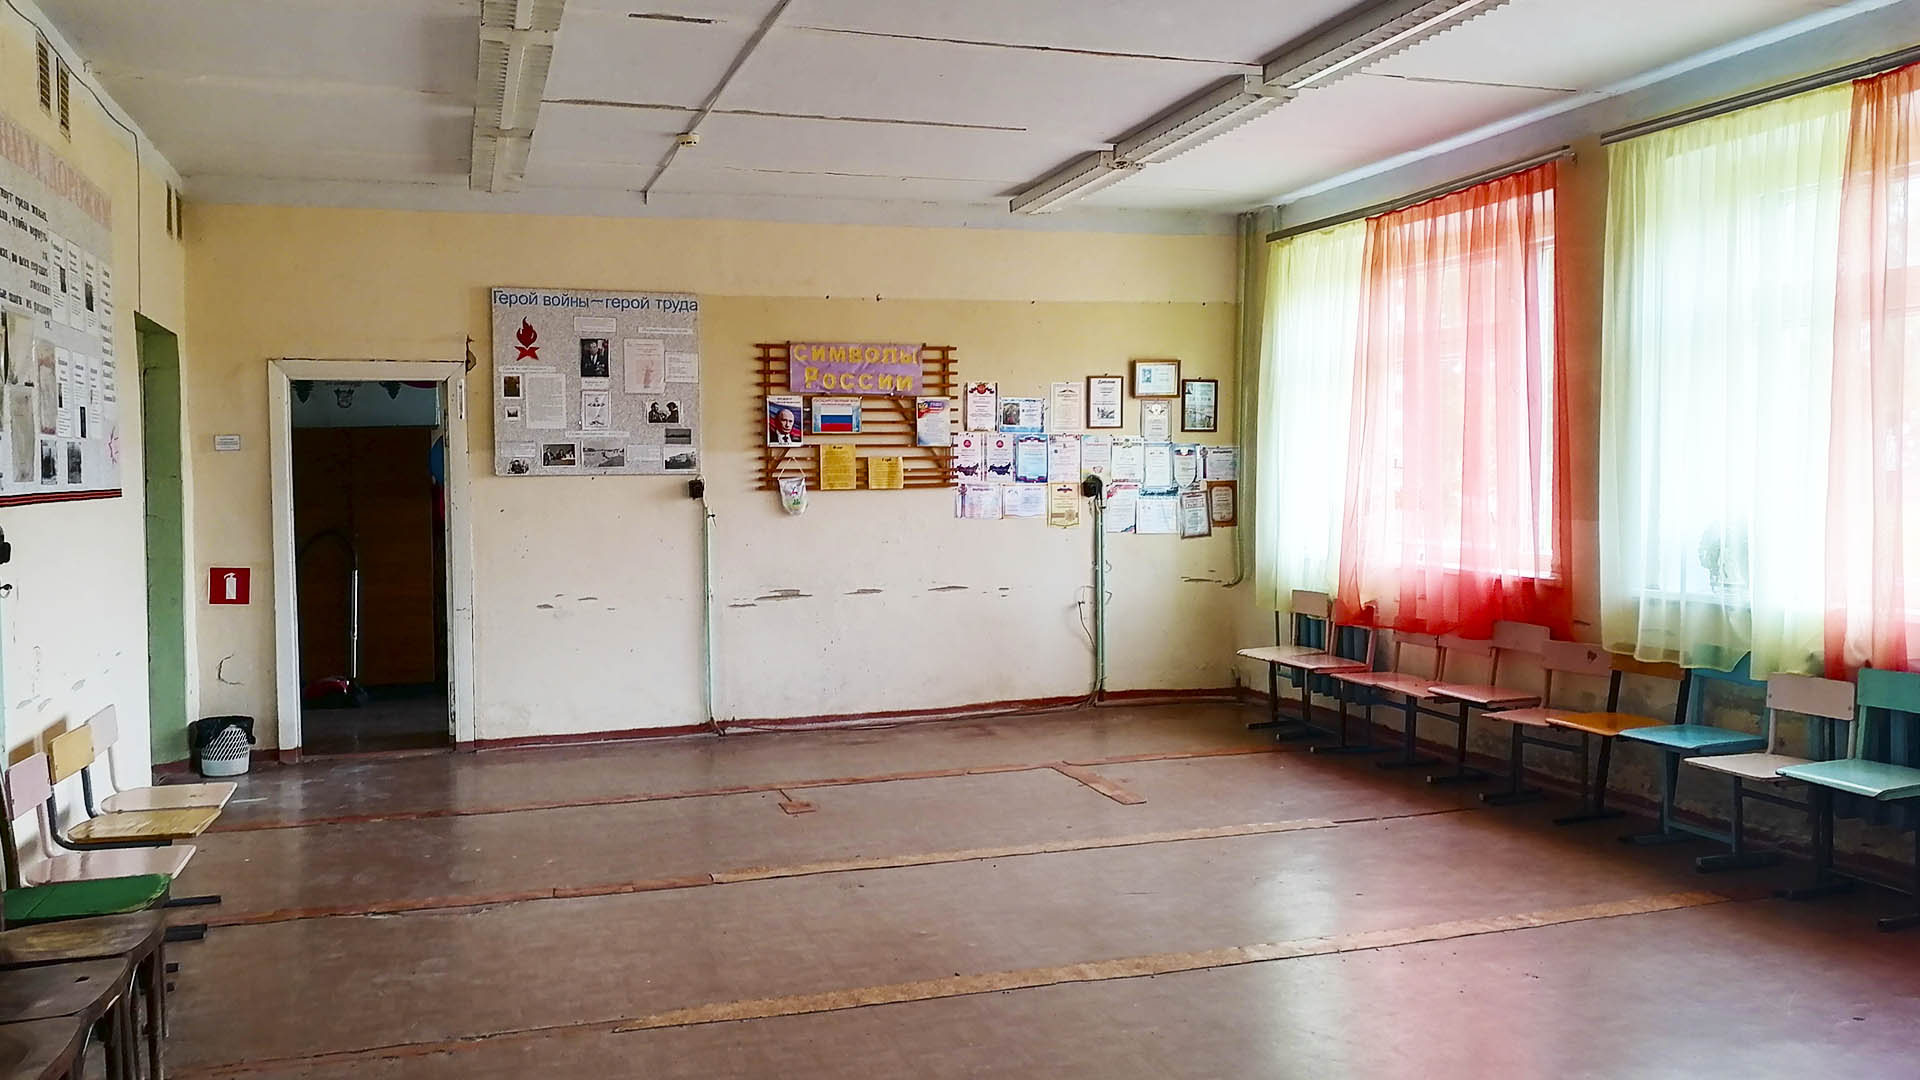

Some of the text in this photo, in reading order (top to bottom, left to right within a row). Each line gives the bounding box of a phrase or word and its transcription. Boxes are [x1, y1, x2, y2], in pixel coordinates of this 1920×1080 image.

[493, 290, 538, 308] Герой
[543, 293, 589, 308] войны
[605, 297, 650, 312] герой
[656, 299, 698, 313] труда
